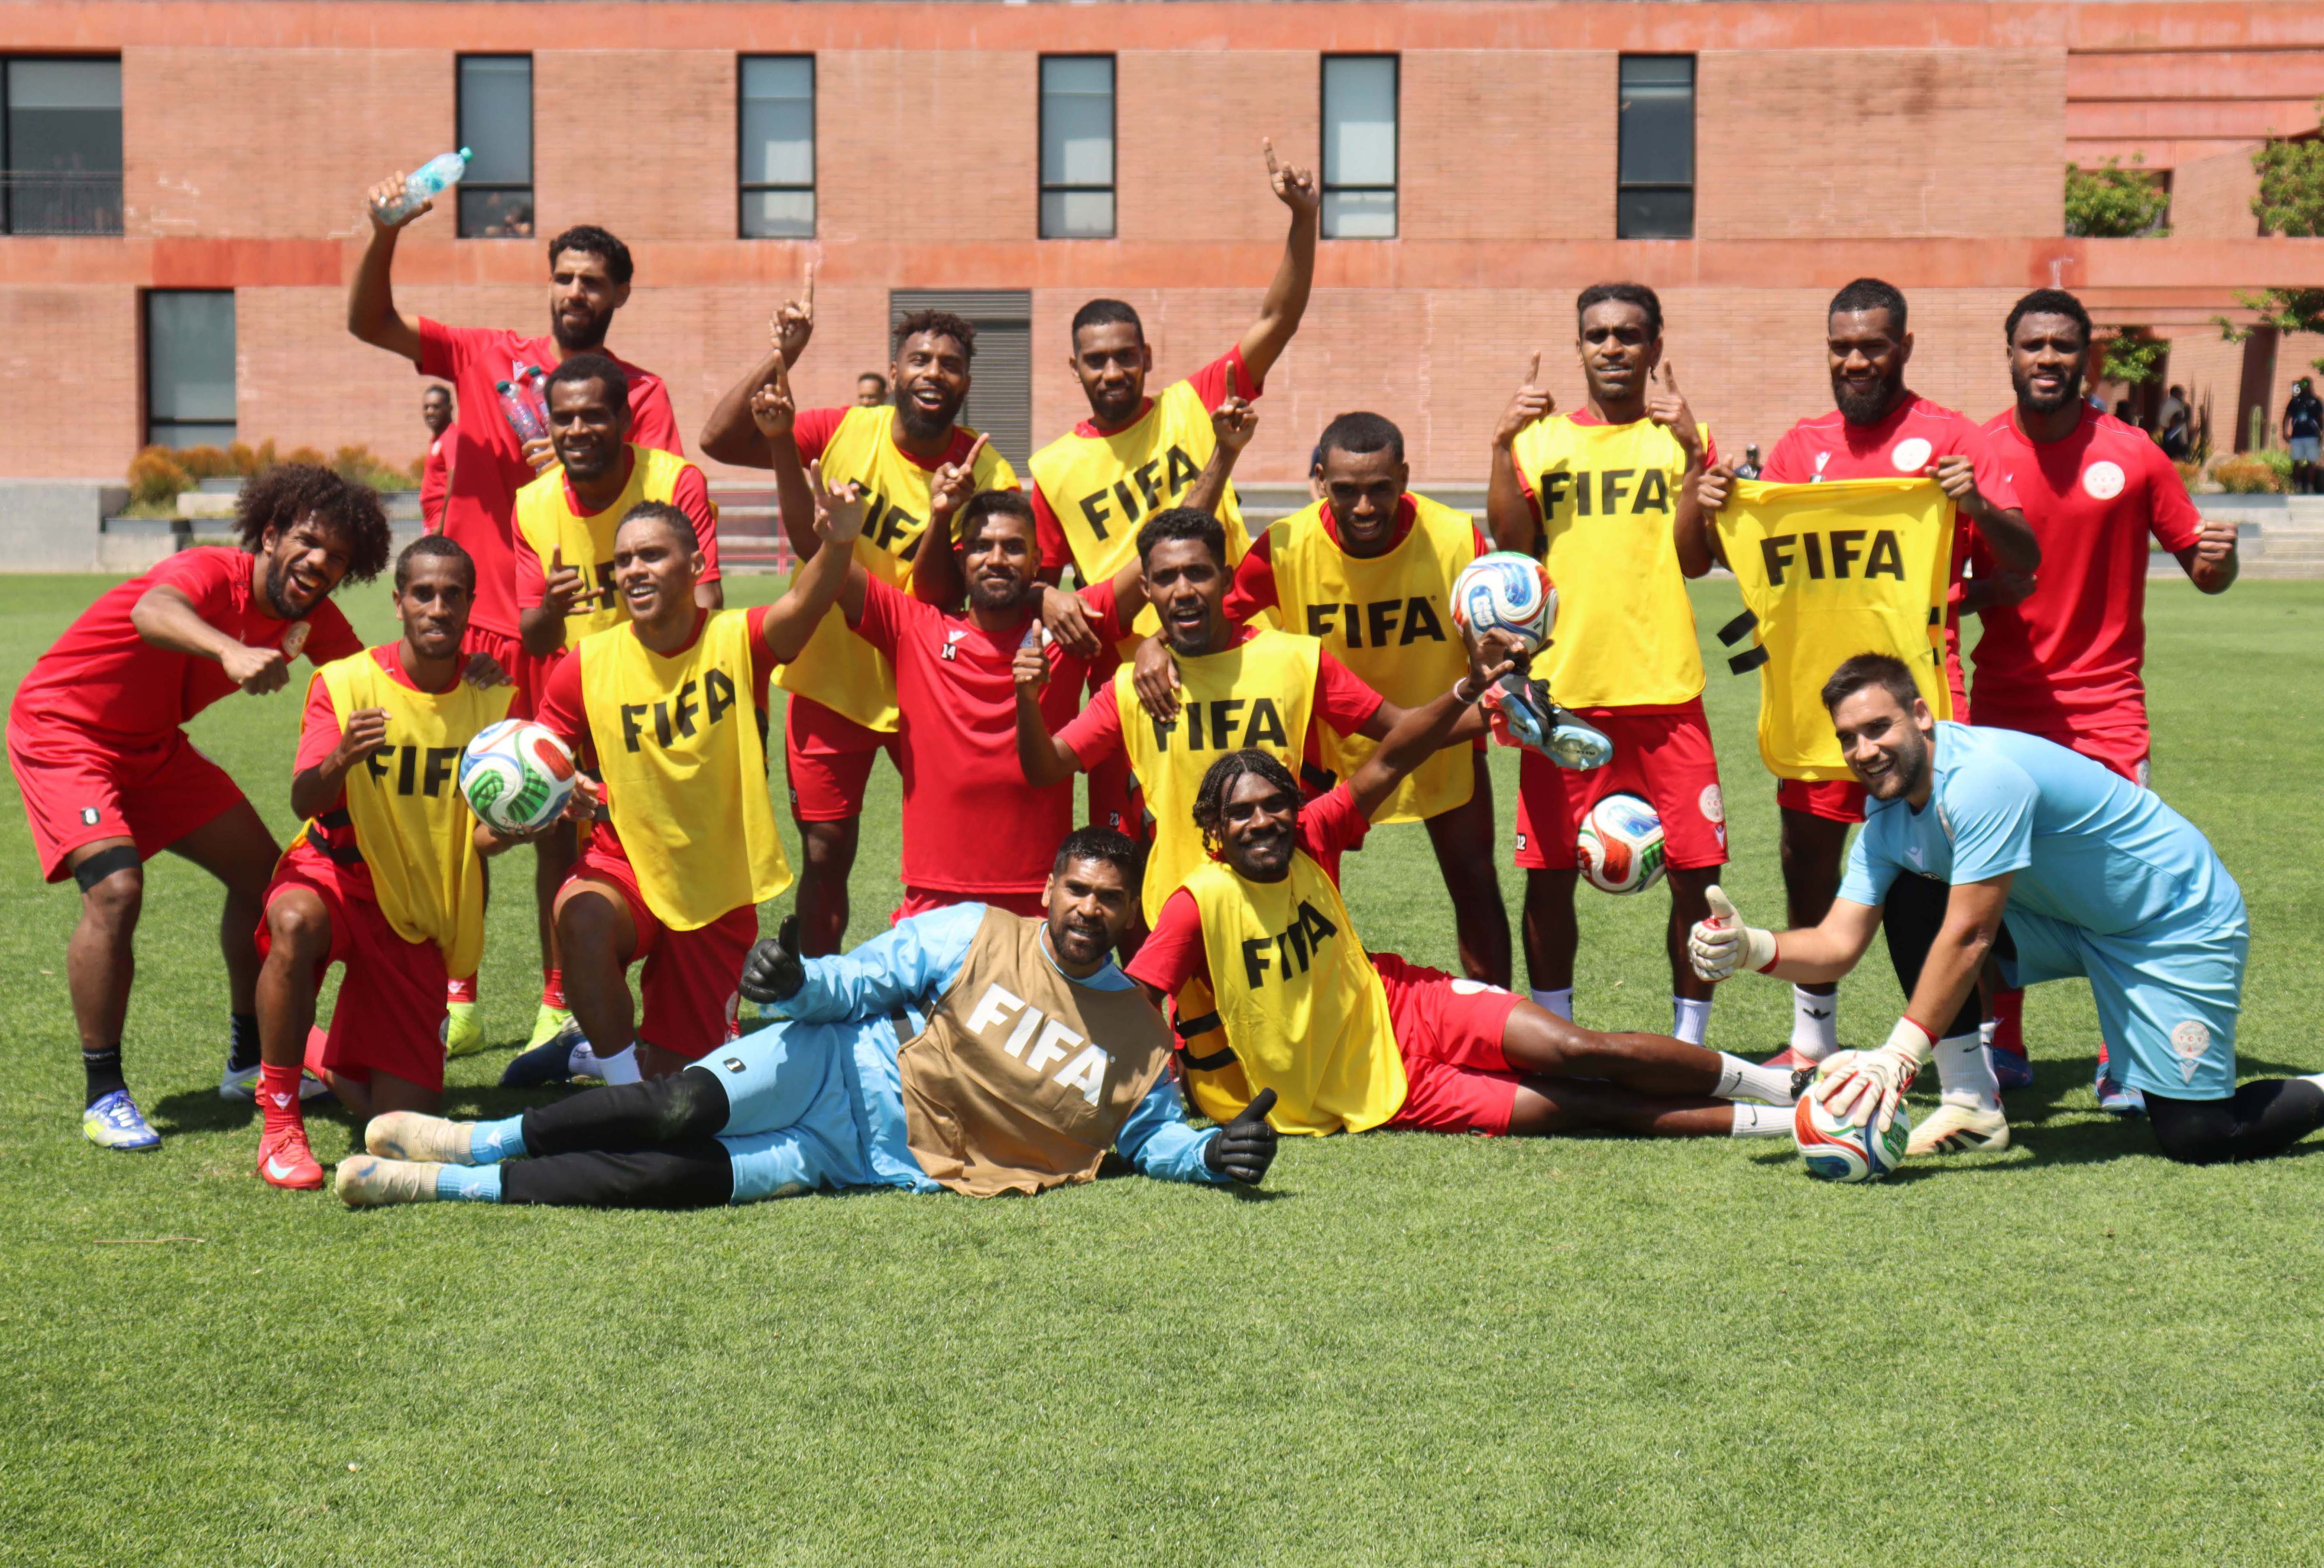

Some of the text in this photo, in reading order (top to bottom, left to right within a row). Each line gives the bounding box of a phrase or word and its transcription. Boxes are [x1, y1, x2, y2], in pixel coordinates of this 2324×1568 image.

[1079, 444, 1202, 541] FIFA
[1541, 469, 1669, 520] FIFA
[848, 478, 925, 562] IF
[1760, 529, 1906, 587] FIFA
[1307, 596, 1446, 648] FIFA
[941, 643, 956, 660] 14
[621, 668, 736, 753] FIFA
[1152, 698, 1288, 752] FIFA
[365, 745, 467, 798] FIF
[1517, 835, 1526, 850] 12
[966, 983, 1108, 1107] FIFA
